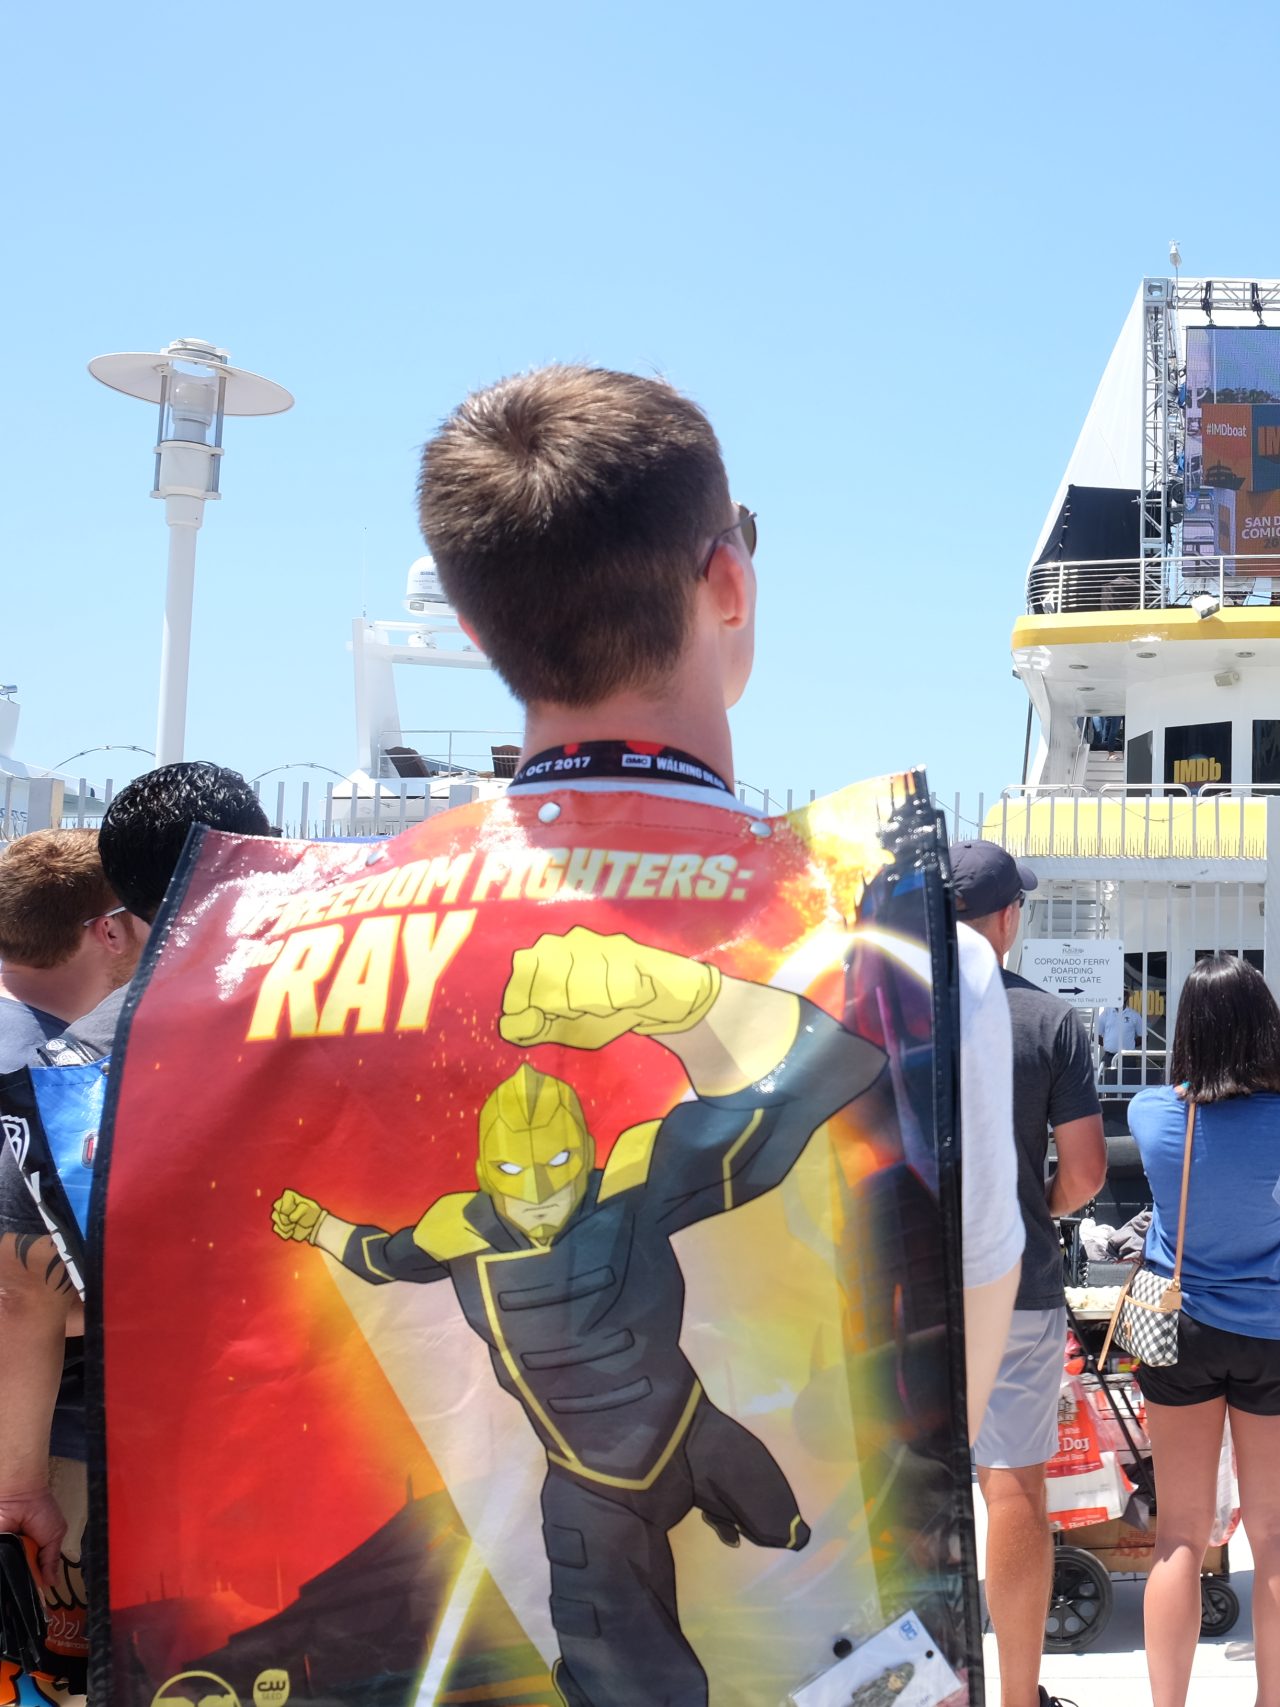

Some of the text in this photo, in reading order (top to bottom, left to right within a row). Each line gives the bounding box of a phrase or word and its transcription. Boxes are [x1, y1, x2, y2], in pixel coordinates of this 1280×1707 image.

[1206, 423, 1247, 438] #IMDboat
[1244, 516, 1271, 528] SAN
[525, 761, 552, 777] OCT
[554, 756, 591, 771] 2017
[1174, 757, 1222, 784] IMDb
[469, 847, 755, 903] FIGHTERS:
[1034, 958, 1110, 966] CORONADO FERRY
[245, 907, 478, 1043] RAY
[1051, 967, 1093, 975] BOARDING
[1043, 976, 1102, 984] AT WEST GATE
[901, 1620, 918, 1640] DC
